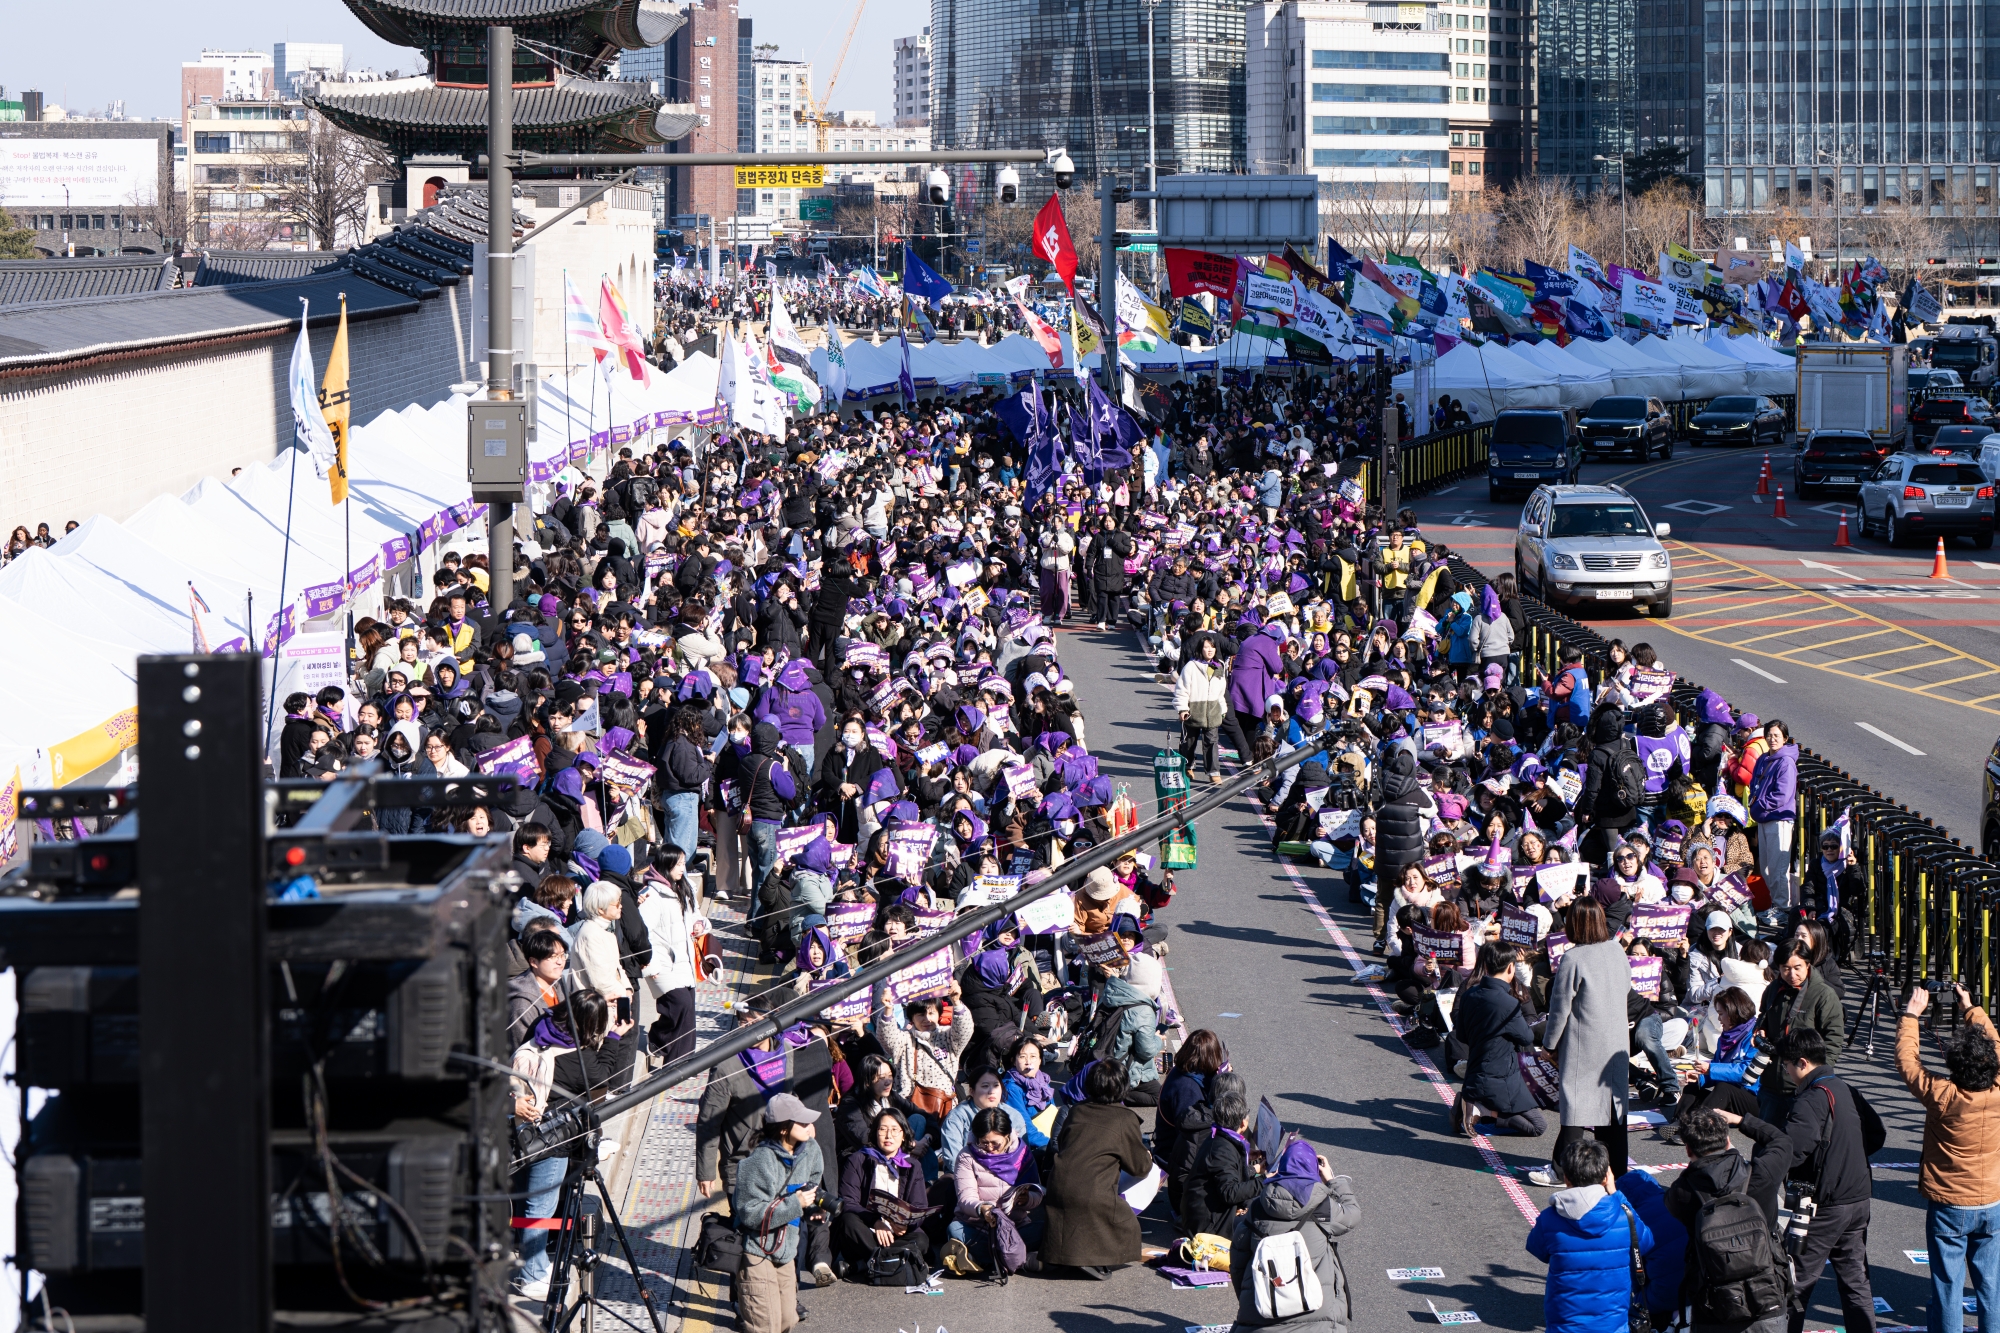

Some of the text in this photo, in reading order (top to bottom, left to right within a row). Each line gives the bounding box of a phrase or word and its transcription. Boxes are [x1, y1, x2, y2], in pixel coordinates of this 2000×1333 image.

[12, 151, 31, 160] Stop!
[84, 151, 98, 160] 공유
[737, 170, 822, 185] 불법주정차 단속중
[1280, 286, 1294, 296] 여는
[289, 648, 322, 656] WOMEN'S
[1633, 1247, 1643, 1269] SONY
